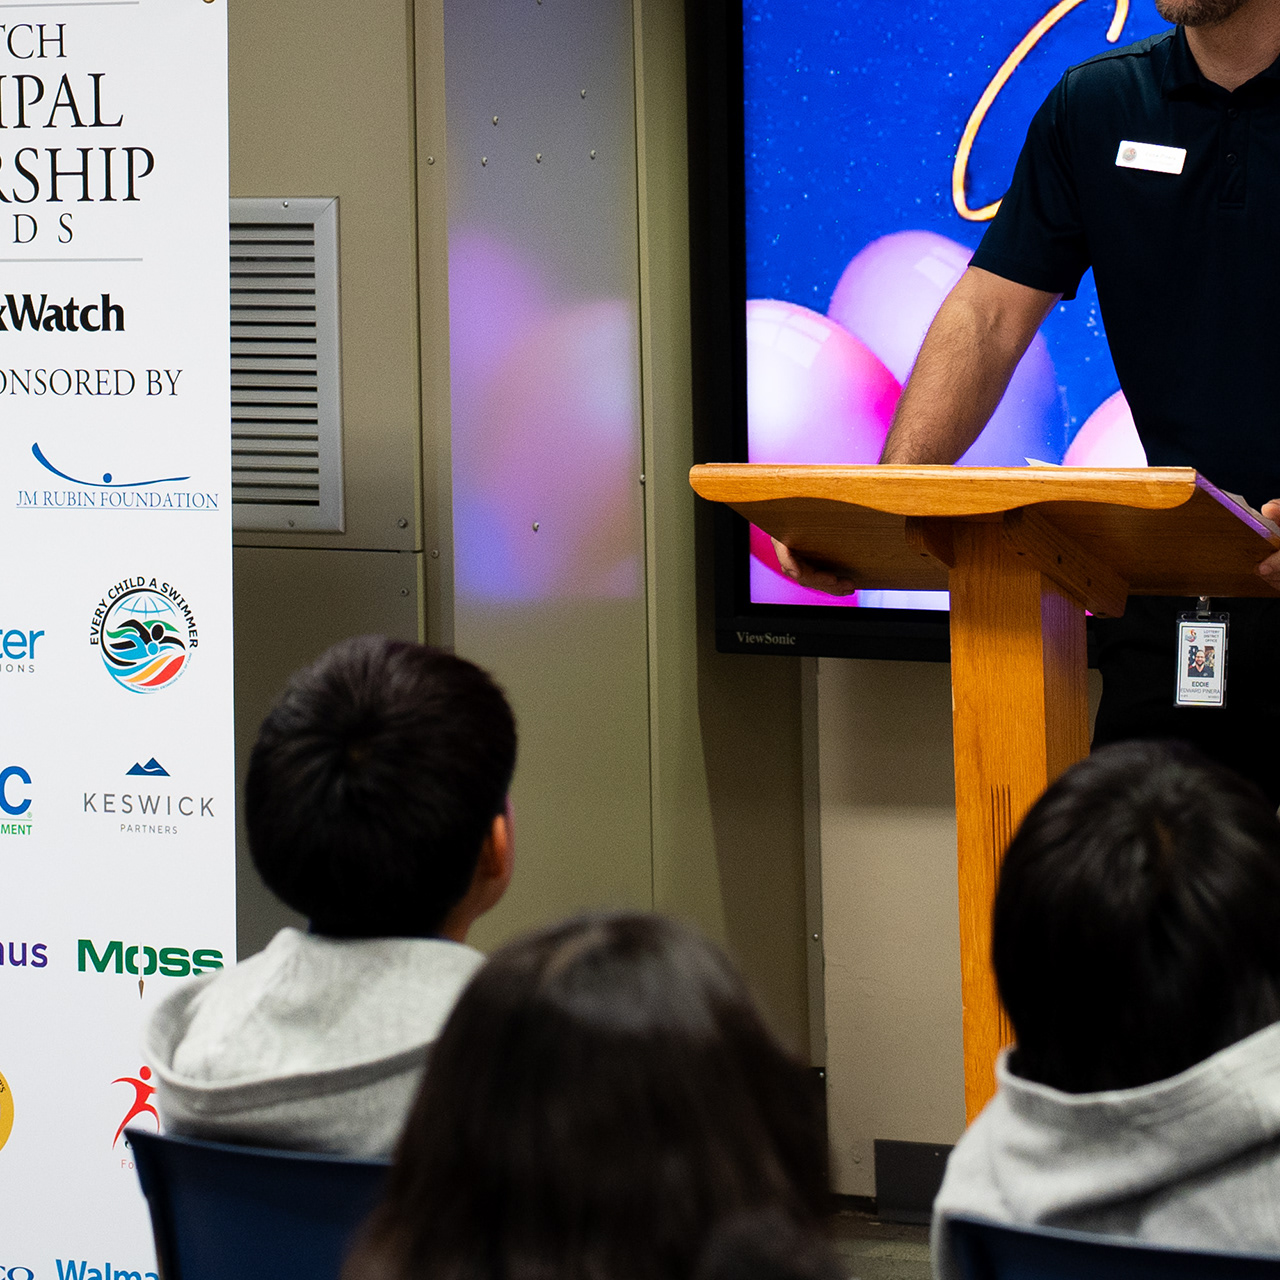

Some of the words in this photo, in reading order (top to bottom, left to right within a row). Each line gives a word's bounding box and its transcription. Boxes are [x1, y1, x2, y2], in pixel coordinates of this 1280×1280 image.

[146, 369, 183, 397] BY
[16, 490, 37, 506] JM
[43, 491, 96, 507] RUBIN
[100, 492, 219, 508] FOUNDATION
[90, 599, 108, 645] EVERY
[107, 576, 145, 600] CHILD
[148, 578, 158, 589] A
[160, 582, 199, 649] SWIMMER
[736, 631, 796, 645] ViewSonic
[83, 792, 215, 818] KESWICK
[120, 823, 178, 835] PARTNERS
